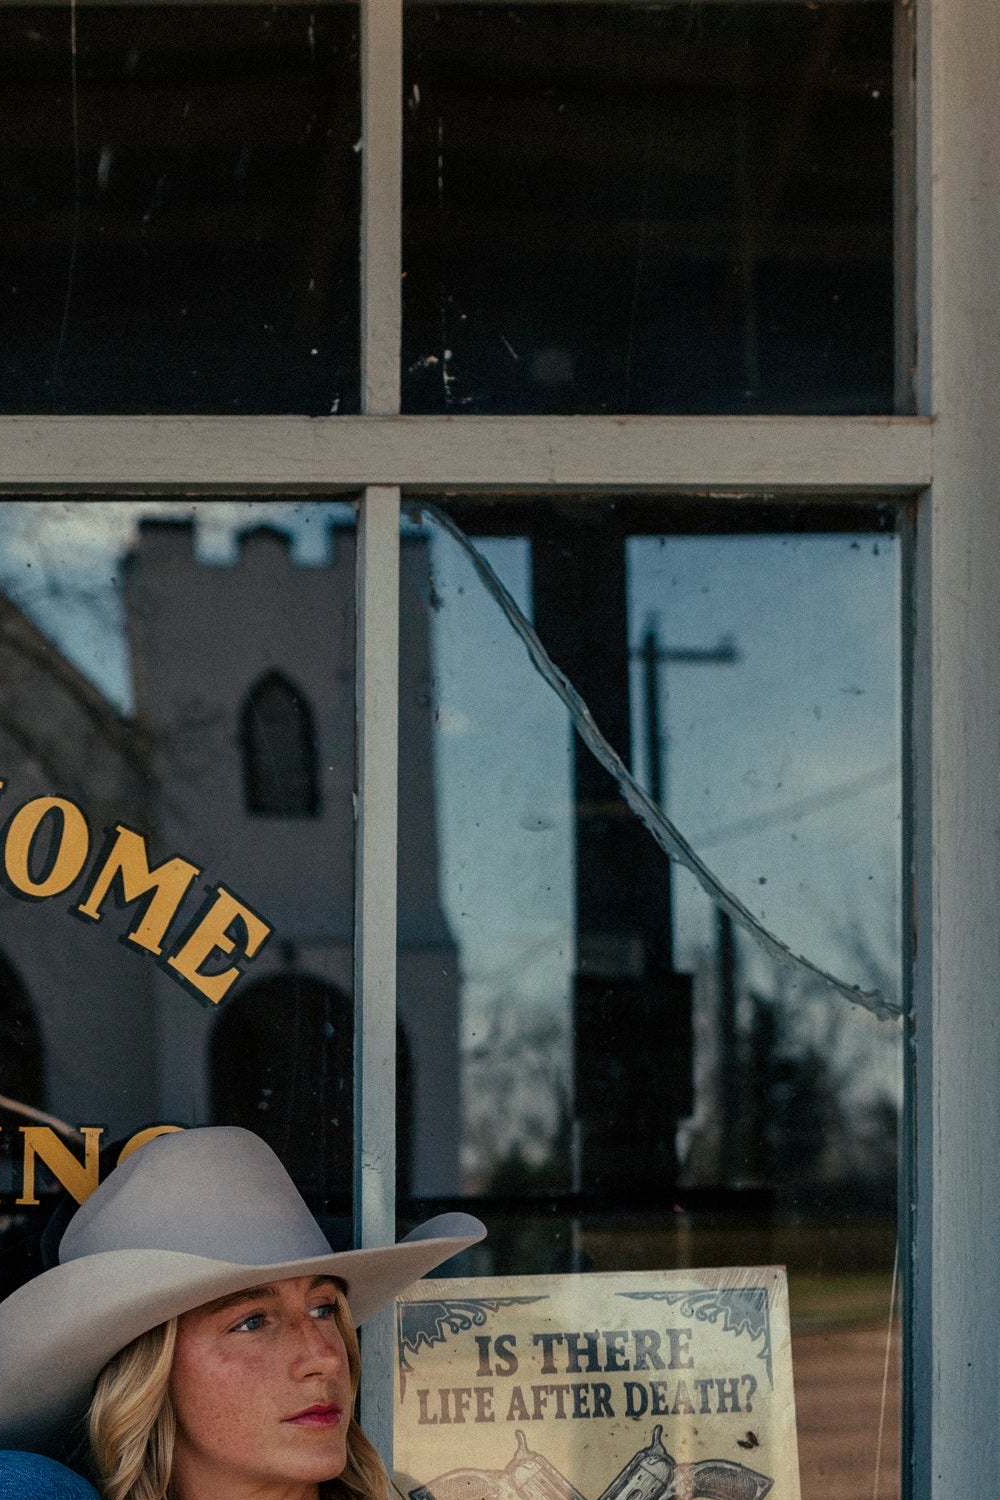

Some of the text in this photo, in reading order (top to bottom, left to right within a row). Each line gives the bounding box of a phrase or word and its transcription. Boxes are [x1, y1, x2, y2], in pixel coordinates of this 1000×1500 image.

[475, 1328, 694, 1377] IS THERE
[417, 1374, 757, 1425] LIFE AFTER DEATH?
